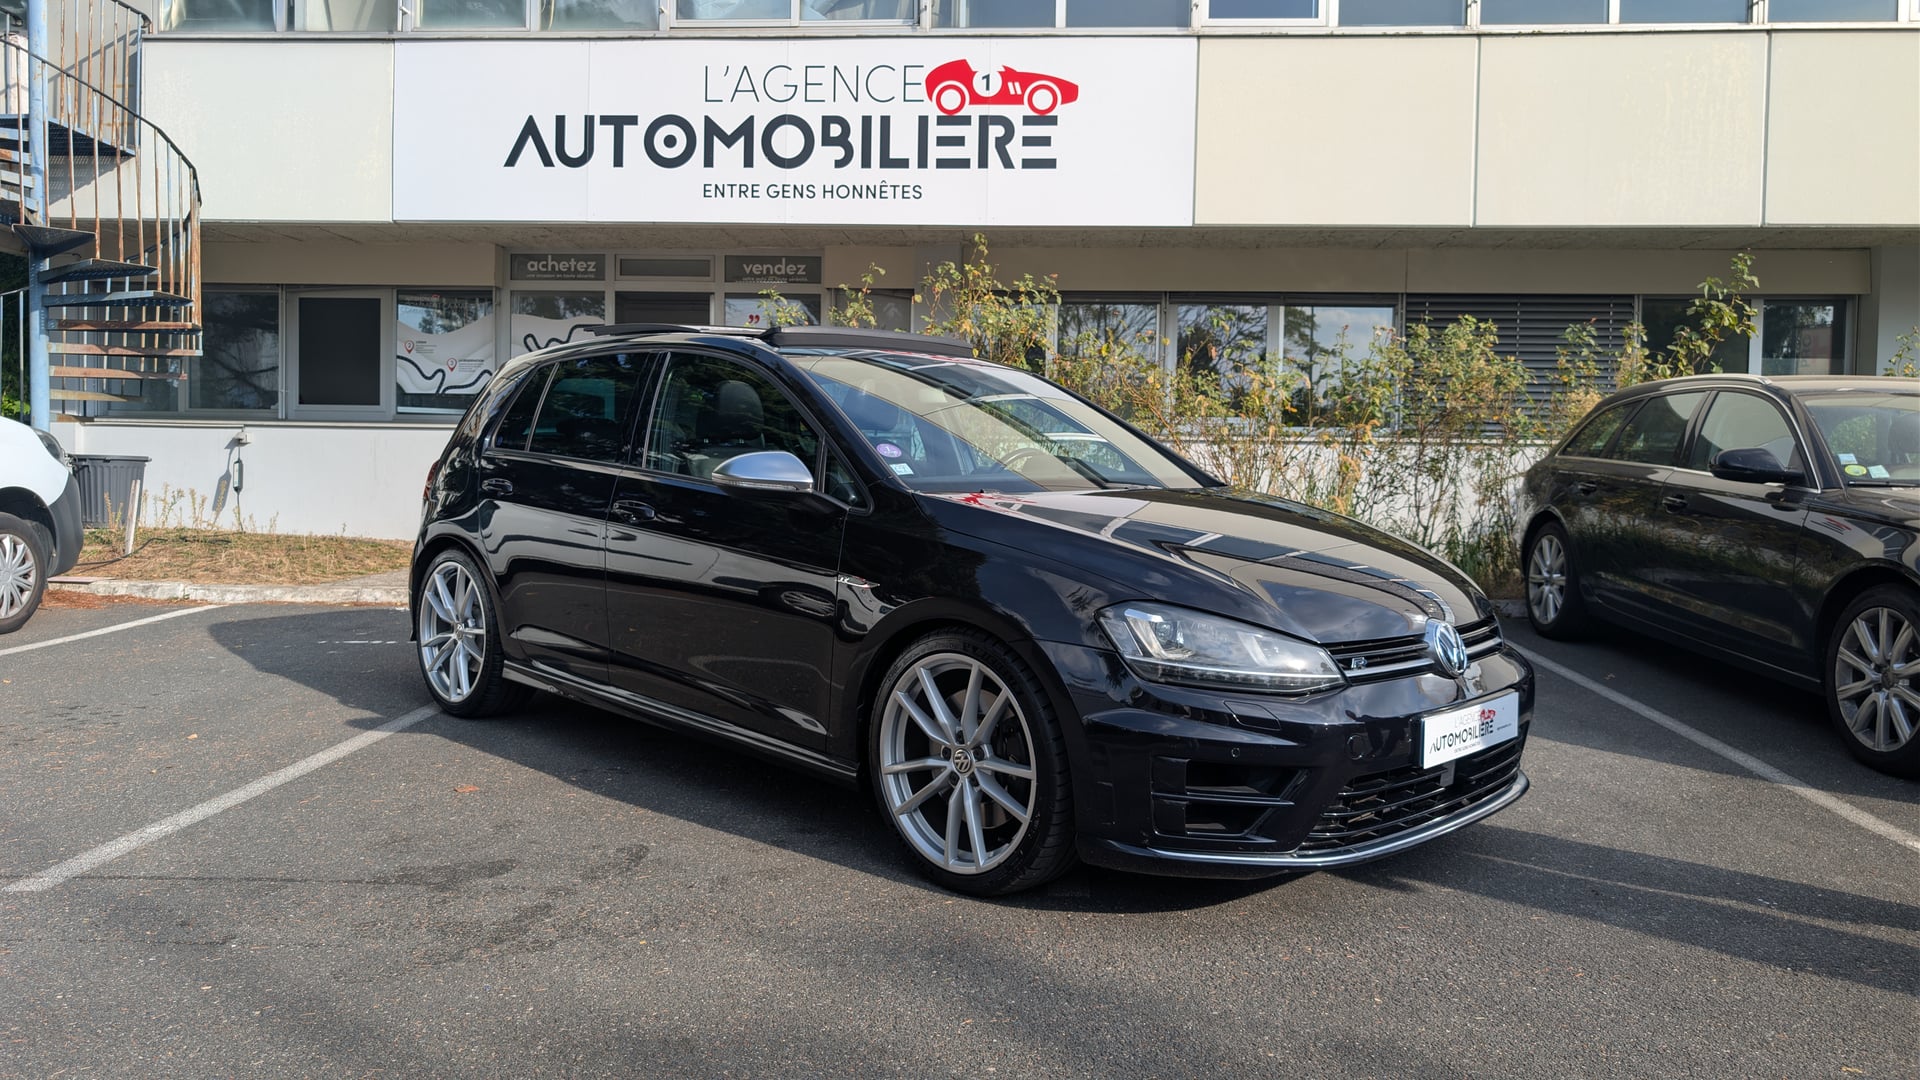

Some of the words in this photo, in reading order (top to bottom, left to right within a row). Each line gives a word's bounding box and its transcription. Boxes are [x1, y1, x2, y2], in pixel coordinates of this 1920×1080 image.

[704, 65, 925, 103] L'AGENCE
[981, 73, 991, 91] 1
[503, 113, 1058, 170] AUTOMOBILIERE
[703, 183, 761, 199] ENTRE
[766, 183, 816, 199] GENS
[822, 179, 923, 200] HONNÊTES
[526, 254, 597, 272] achetez
[742, 257, 807, 275] vendez
[1429, 719, 1494, 755] AUTOMOBILIERE
